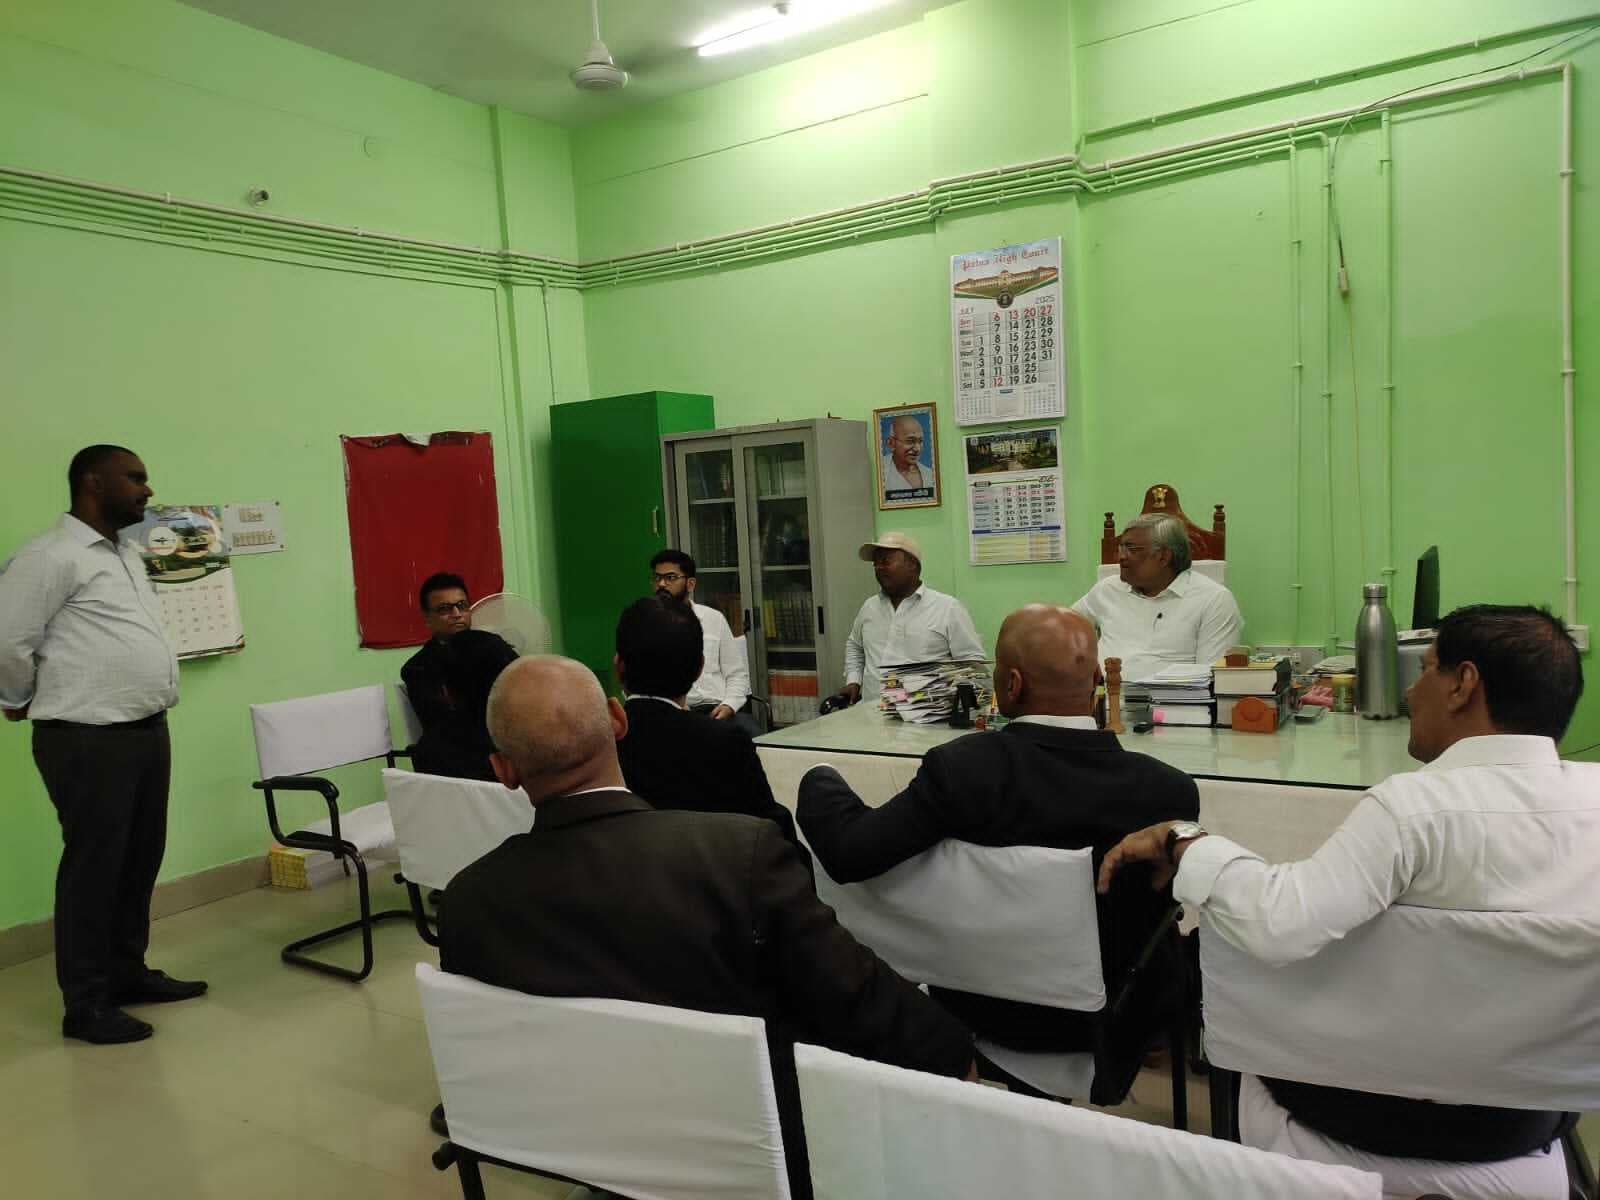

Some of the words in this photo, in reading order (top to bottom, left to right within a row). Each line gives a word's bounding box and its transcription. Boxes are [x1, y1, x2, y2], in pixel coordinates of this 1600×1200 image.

[1035, 294, 1055, 305] 2025
[993, 312, 1001, 321] 6
[1009, 310, 1019, 320] 13
[1024, 307, 1036, 318] 20
[1040, 304, 1053, 315] 27
[994, 323, 1001, 332] 7
[1009, 321, 1019, 330] 14
[1025, 319, 1035, 329] 21
[1040, 316, 1053, 327] 28
[994, 334, 1001, 343] 8
[1009, 332, 1019, 341] 15
[1024, 330, 1037, 340] 22
[1040, 327, 1053, 338] 29
[978, 347, 985, 356] 2
[994, 345, 1001, 354] 9
[1009, 344, 1019, 353] 16
[1024, 342, 1037, 351] 23
[1040, 339, 1053, 349] 30
[978, 358, 985, 367] 3
[993, 356, 1003, 365] 10
[1009, 354, 1019, 363] 17
[1024, 352, 1037, 362] 24
[1041, 350, 1052, 360] 31
[979, 368, 985, 377] 4
[994, 367, 1002, 376] 11
[1009, 365, 1019, 375] 18
[1024, 363, 1037, 373] 25
[979, 379, 985, 389] 5
[993, 377, 1003, 387] 12
[1009, 375, 1020, 385] 19
[1024, 374, 1037, 384] 26
